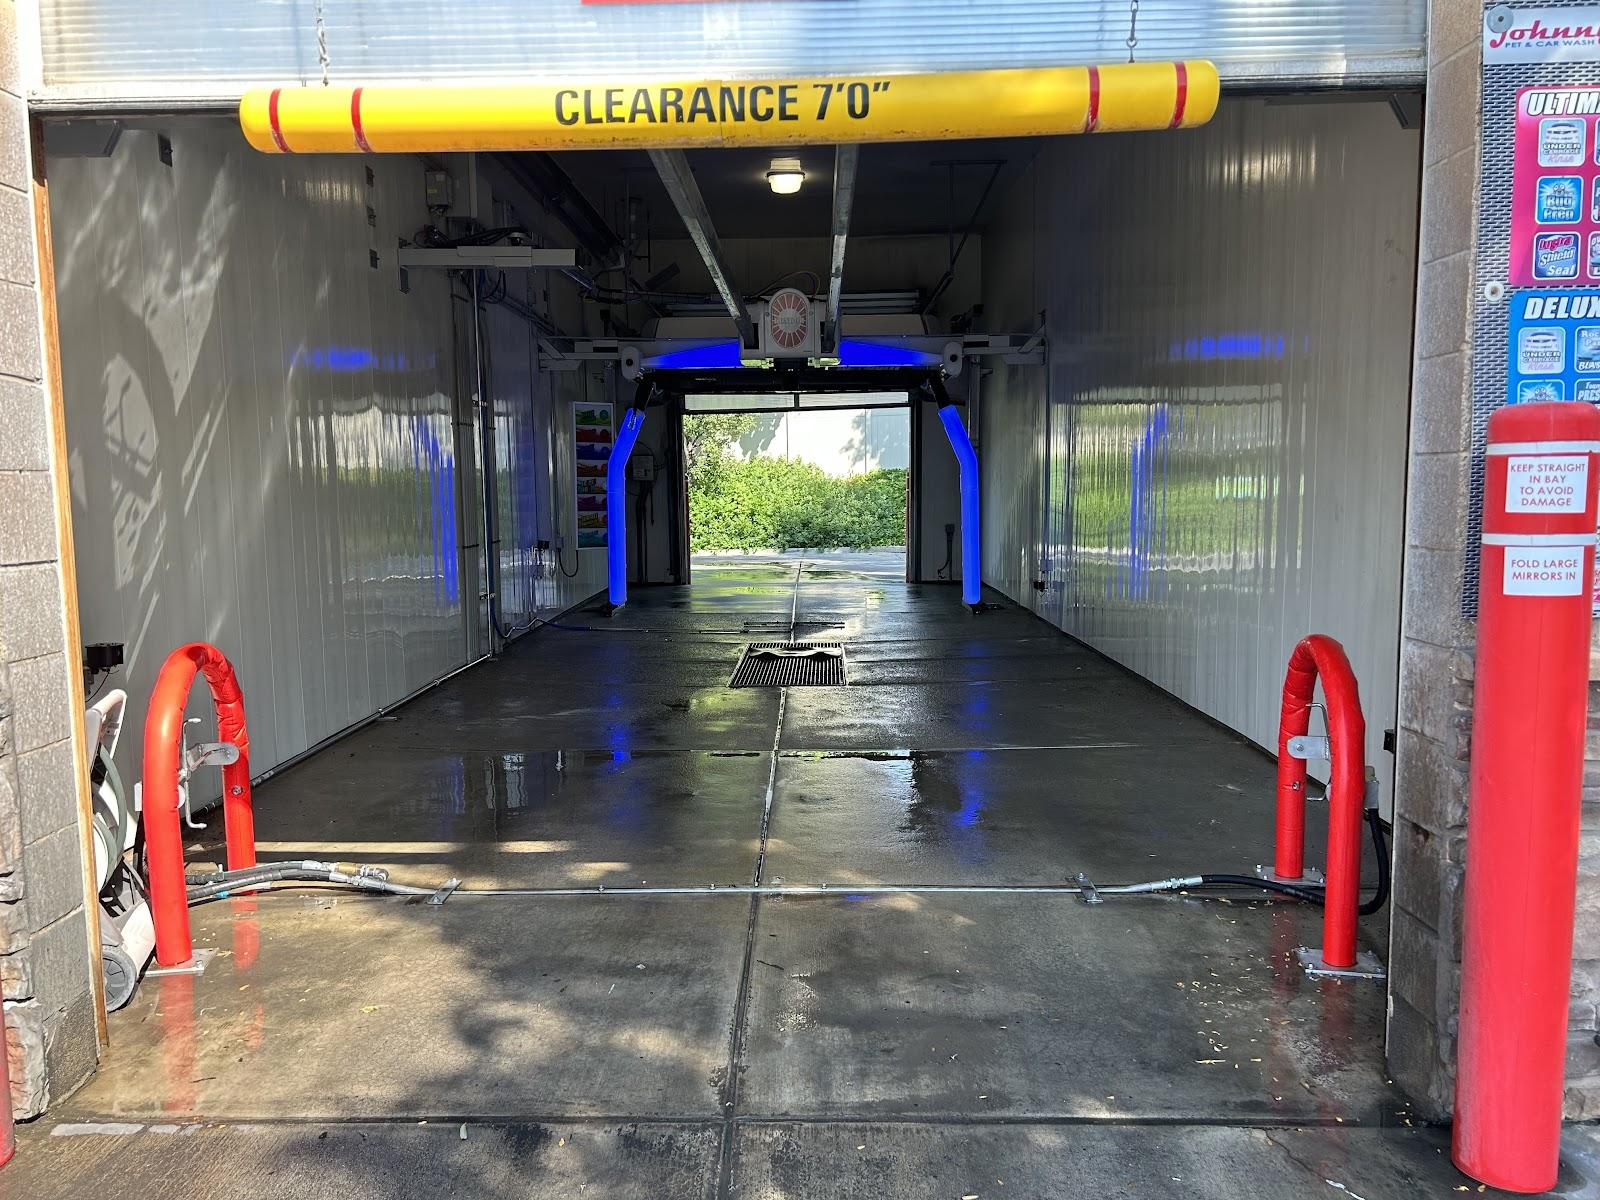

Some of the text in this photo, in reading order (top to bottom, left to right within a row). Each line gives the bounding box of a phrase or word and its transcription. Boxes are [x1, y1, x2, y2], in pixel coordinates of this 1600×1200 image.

[1489, 19, 1600, 48] Johnn
[555, 84, 799, 126] CLEARANCE
[1543, 142, 1581, 150] UNDER
[1546, 195, 1573, 208] Bug
[1543, 208, 1575, 220] Prep
[1539, 248, 1575, 267] Shield
[1547, 264, 1576, 276] Seal
[1522, 350, 1561, 358] UNDER
[1510, 463, 1586, 473] KEEP STRAIGHT
[1529, 475, 1567, 483] IN BAY
[1520, 486, 1574, 495] TO AVOID
[1521, 497, 1572, 506] DAMAGE
[1511, 559, 1578, 568] FOLD LARGE
[1512, 572, 1576, 581] MIRRORS IN
